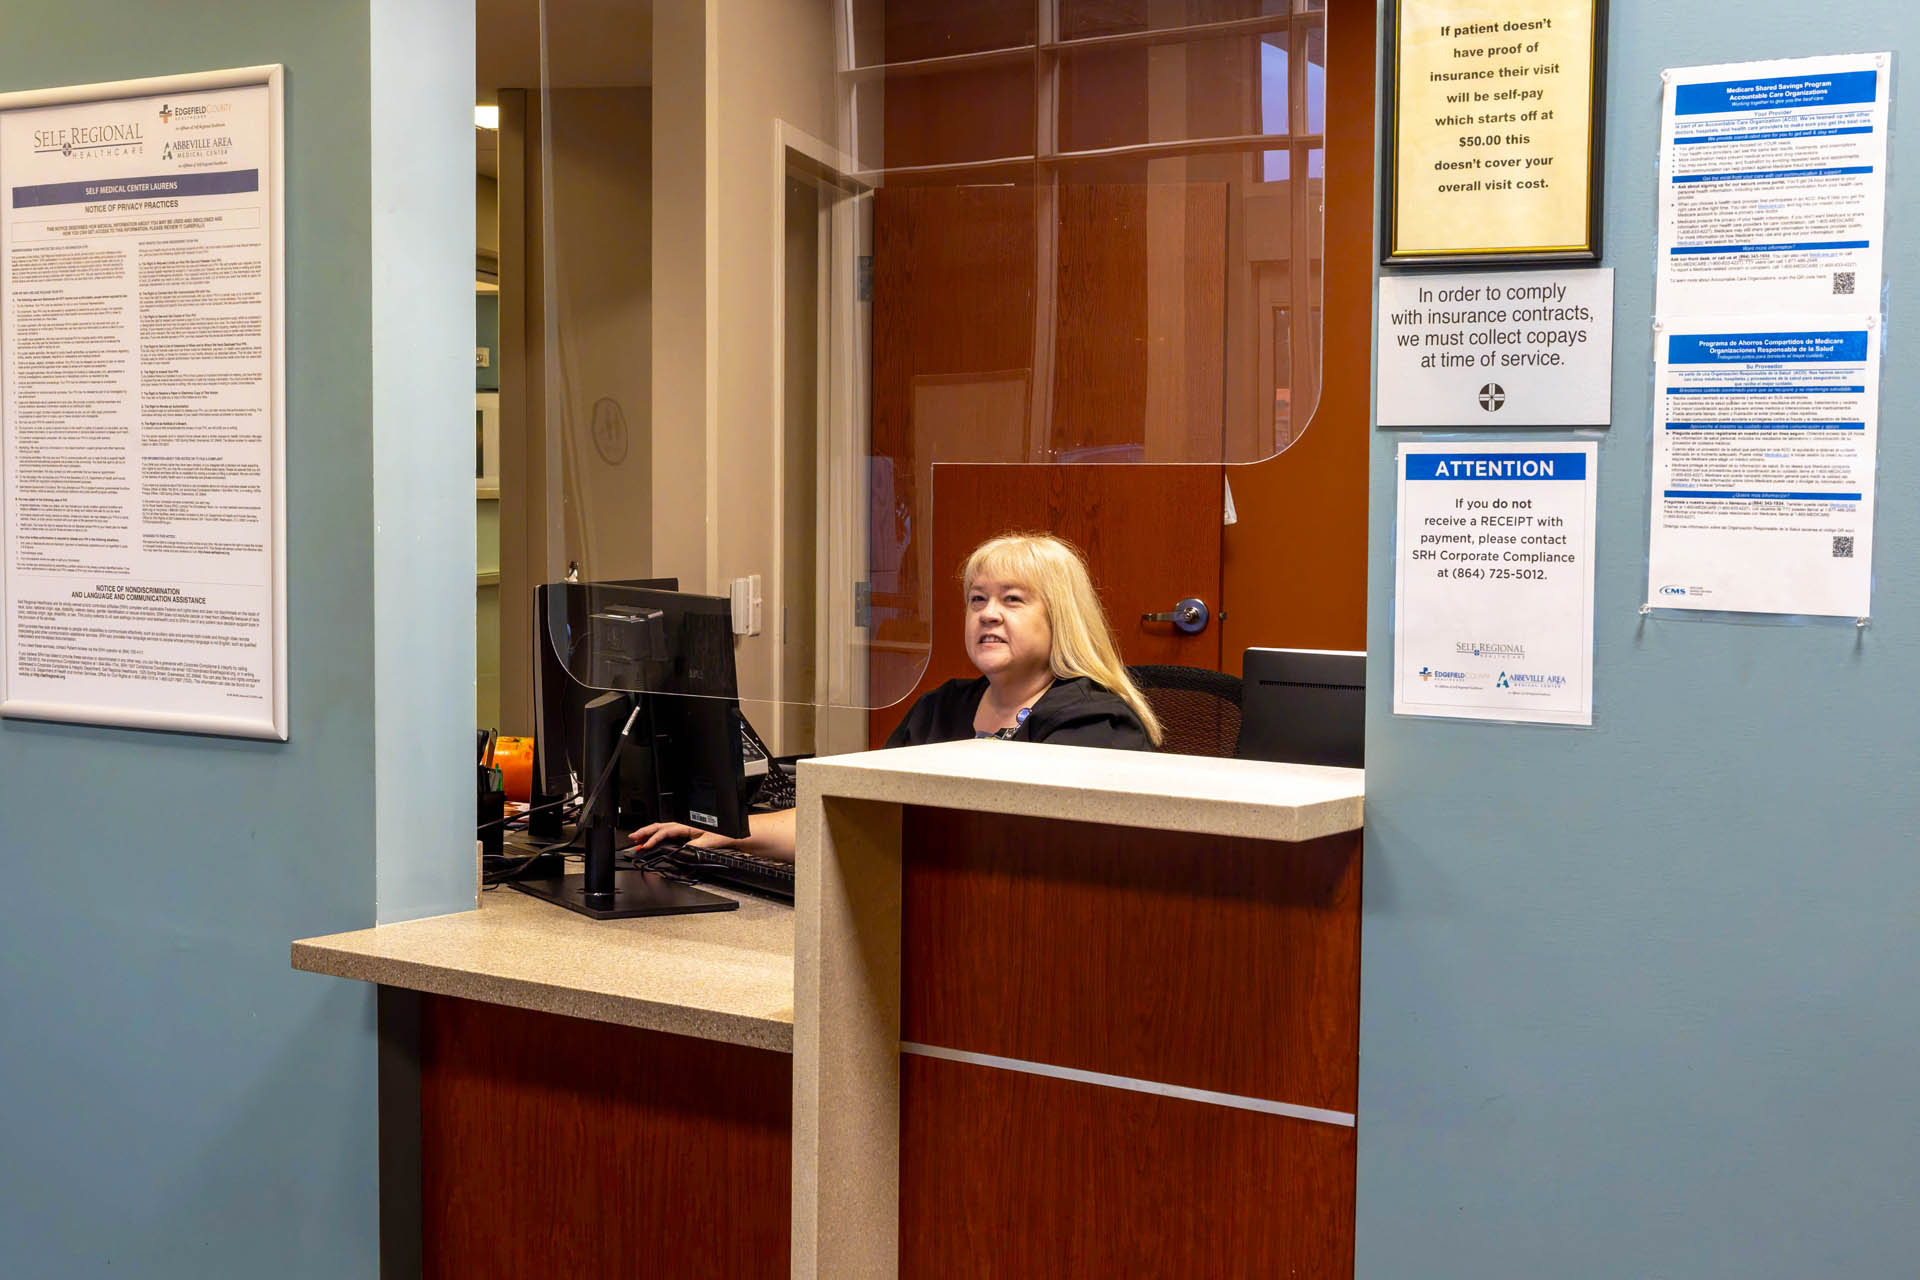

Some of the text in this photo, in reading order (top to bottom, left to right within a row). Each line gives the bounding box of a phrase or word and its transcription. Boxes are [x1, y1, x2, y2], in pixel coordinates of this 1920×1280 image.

[1441, 18, 1552, 38] If patient doesn't
[1454, 42, 1539, 58] have proof of
[1430, 64, 1560, 82] insurance their visit
[1778, 83, 1803, 92] Savings
[1804, 81, 1832, 90] Program
[1447, 89, 1544, 103] will be self-pay
[1729, 93, 1768, 101] Accountable
[1785, 89, 1828, 99] Organizations
[1435, 110, 1554, 126] which starts off at
[34, 123, 143, 148] SELF REGIONAL
[1459, 134, 1530, 148] $50.00 this
[172, 137, 232, 150] ABBEVILLE AREA
[72, 146, 143, 159] HEALTHCARE
[1434, 157, 1554, 171] doesn't cover your
[85, 182, 178, 195] SELF MEDICAL CENTER LAURENS
[1438, 178, 1549, 193] overall visit cost.
[85, 200, 179, 213] NOTICE OF PRIVACY PRACTICES
[1420, 282, 1567, 303] In order to comply
[1391, 305, 1593, 325] with insurance contracts,
[1397, 329, 1587, 348] we must collect copays
[1421, 350, 1564, 368] at time of service.
[1435, 460, 1554, 476] ATTENTION
[1456, 498, 1532, 511] If you do not
[1425, 516, 1563, 527] receive a RECEIPT with
[1421, 533, 1567, 545] payment, please contact
[1412, 550, 1575, 564] SRH Corporate Compliance
[1437, 568, 1547, 580] at (864) 725-5012.
[125, 586, 180, 595] NONDISCRIMINATION
[1456, 641, 1525, 653] SELF REGIONAL
[1509, 674, 1566, 684] ABBEVILLE AREA
